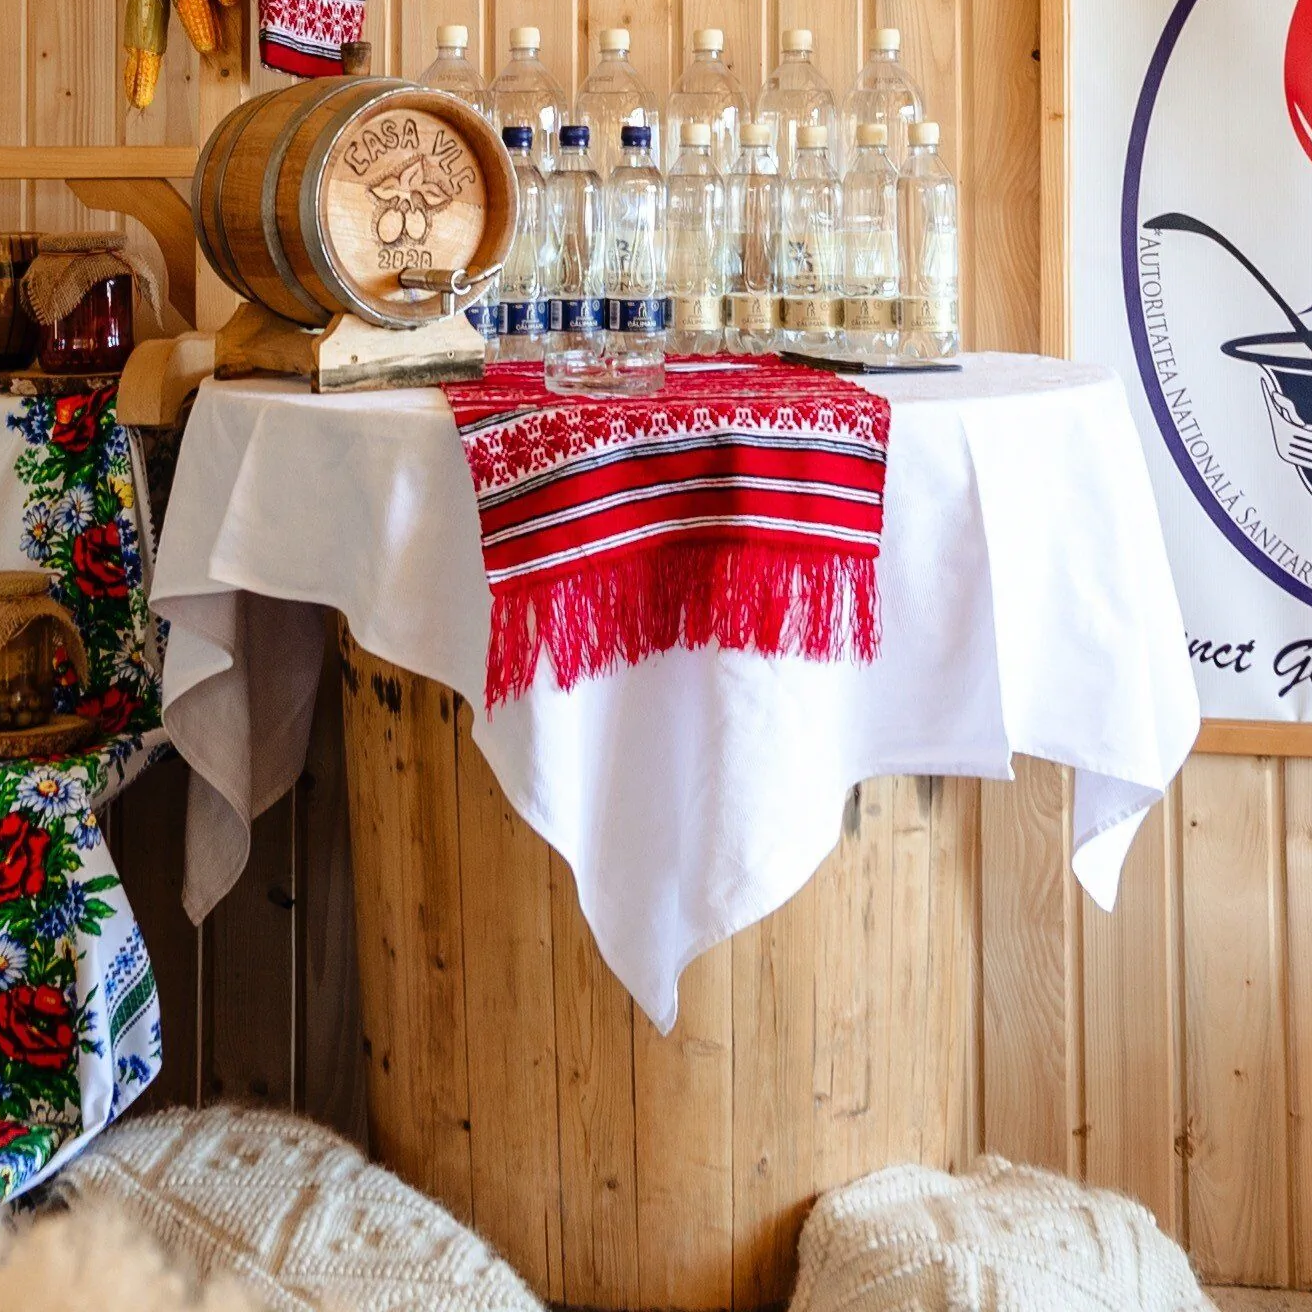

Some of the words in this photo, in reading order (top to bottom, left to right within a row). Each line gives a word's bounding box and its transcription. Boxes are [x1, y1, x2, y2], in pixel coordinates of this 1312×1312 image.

[344, 118, 421, 176] CASA
[432, 130, 476, 195] VLC
[1185, 631, 1256, 674] nct
